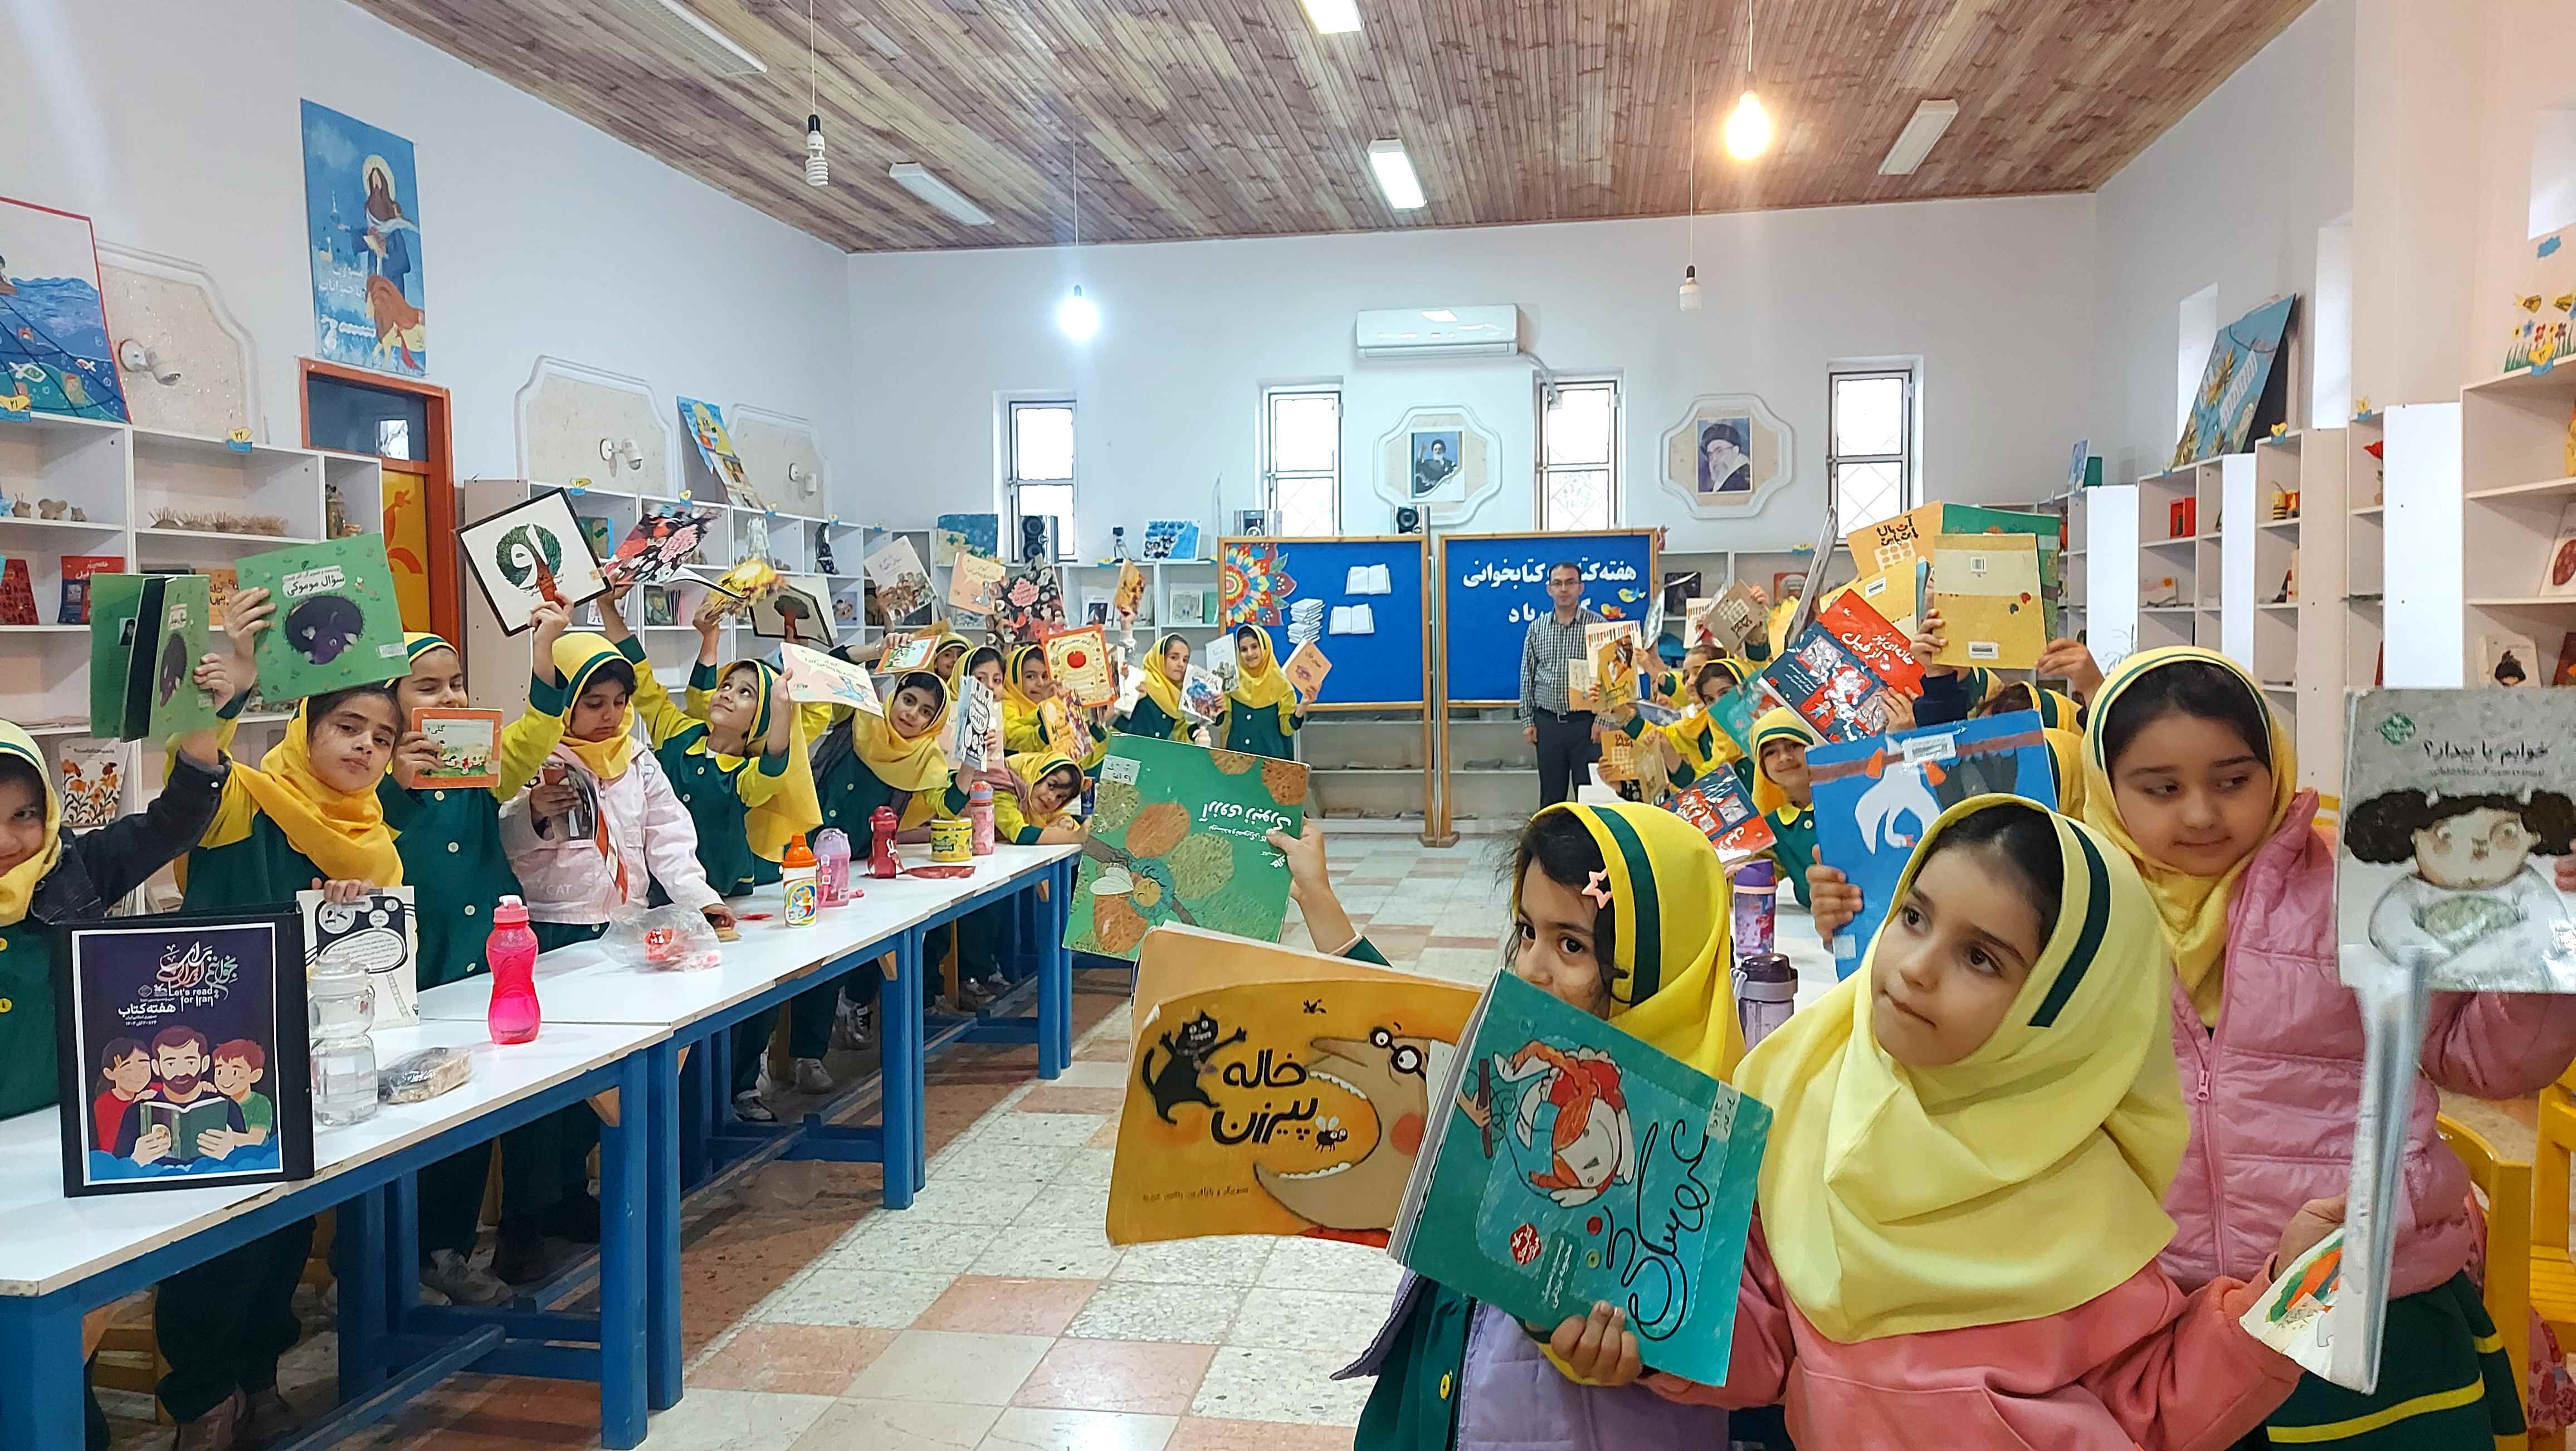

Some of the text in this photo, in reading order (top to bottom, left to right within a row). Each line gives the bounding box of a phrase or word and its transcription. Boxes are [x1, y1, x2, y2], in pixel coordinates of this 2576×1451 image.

[9, 400, 18, 410] ۲۱
[235, 430, 243, 440] ۲۲
[1462, 558, 1546, 589] کتابخوانی
[1580, 557, 1601, 581] کتا
[1599, 560, 1637, 581] هفته
[287, 581, 319, 596] موموکی
[321, 574, 344, 587] سؤال
[1841, 632, 1873, 653] فیل
[2481, 739, 2494, 763] یا
[1198, 800, 1242, 822] آرزوی
[168, 981, 213, 997] Let's read
[118, 1002, 177, 1018] هفته کتاب
[180, 996, 214, 1012] for Iran
[1221, 1049, 1307, 1089] خاله
[1210, 1097, 1319, 1145] پیرزن
